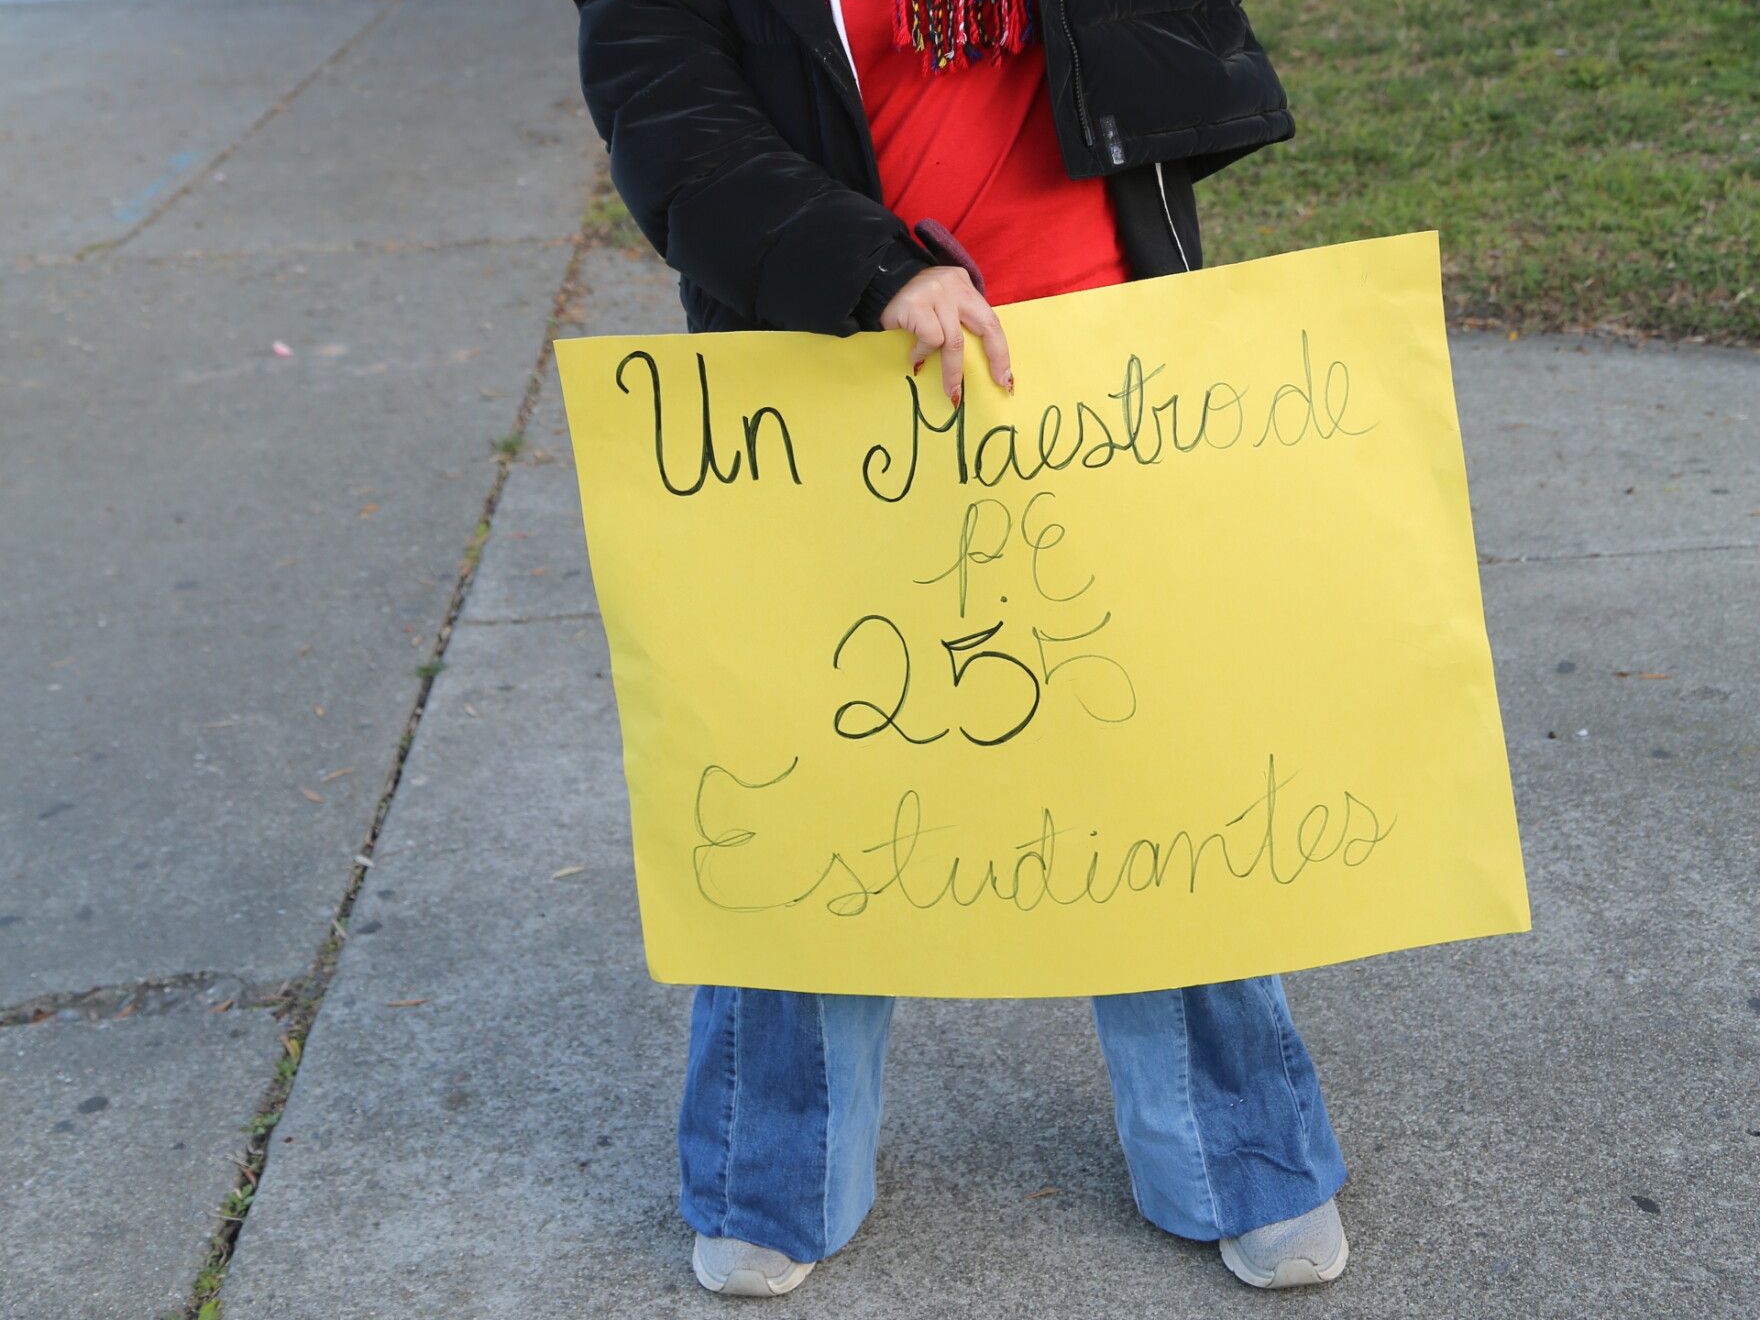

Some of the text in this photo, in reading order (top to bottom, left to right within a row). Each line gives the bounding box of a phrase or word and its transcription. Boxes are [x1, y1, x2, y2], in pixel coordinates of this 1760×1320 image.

[616, 329, 1381, 502] Un Maestro de
[833, 611, 1137, 747] 255
[694, 753, 1398, 917] Estudiantes
